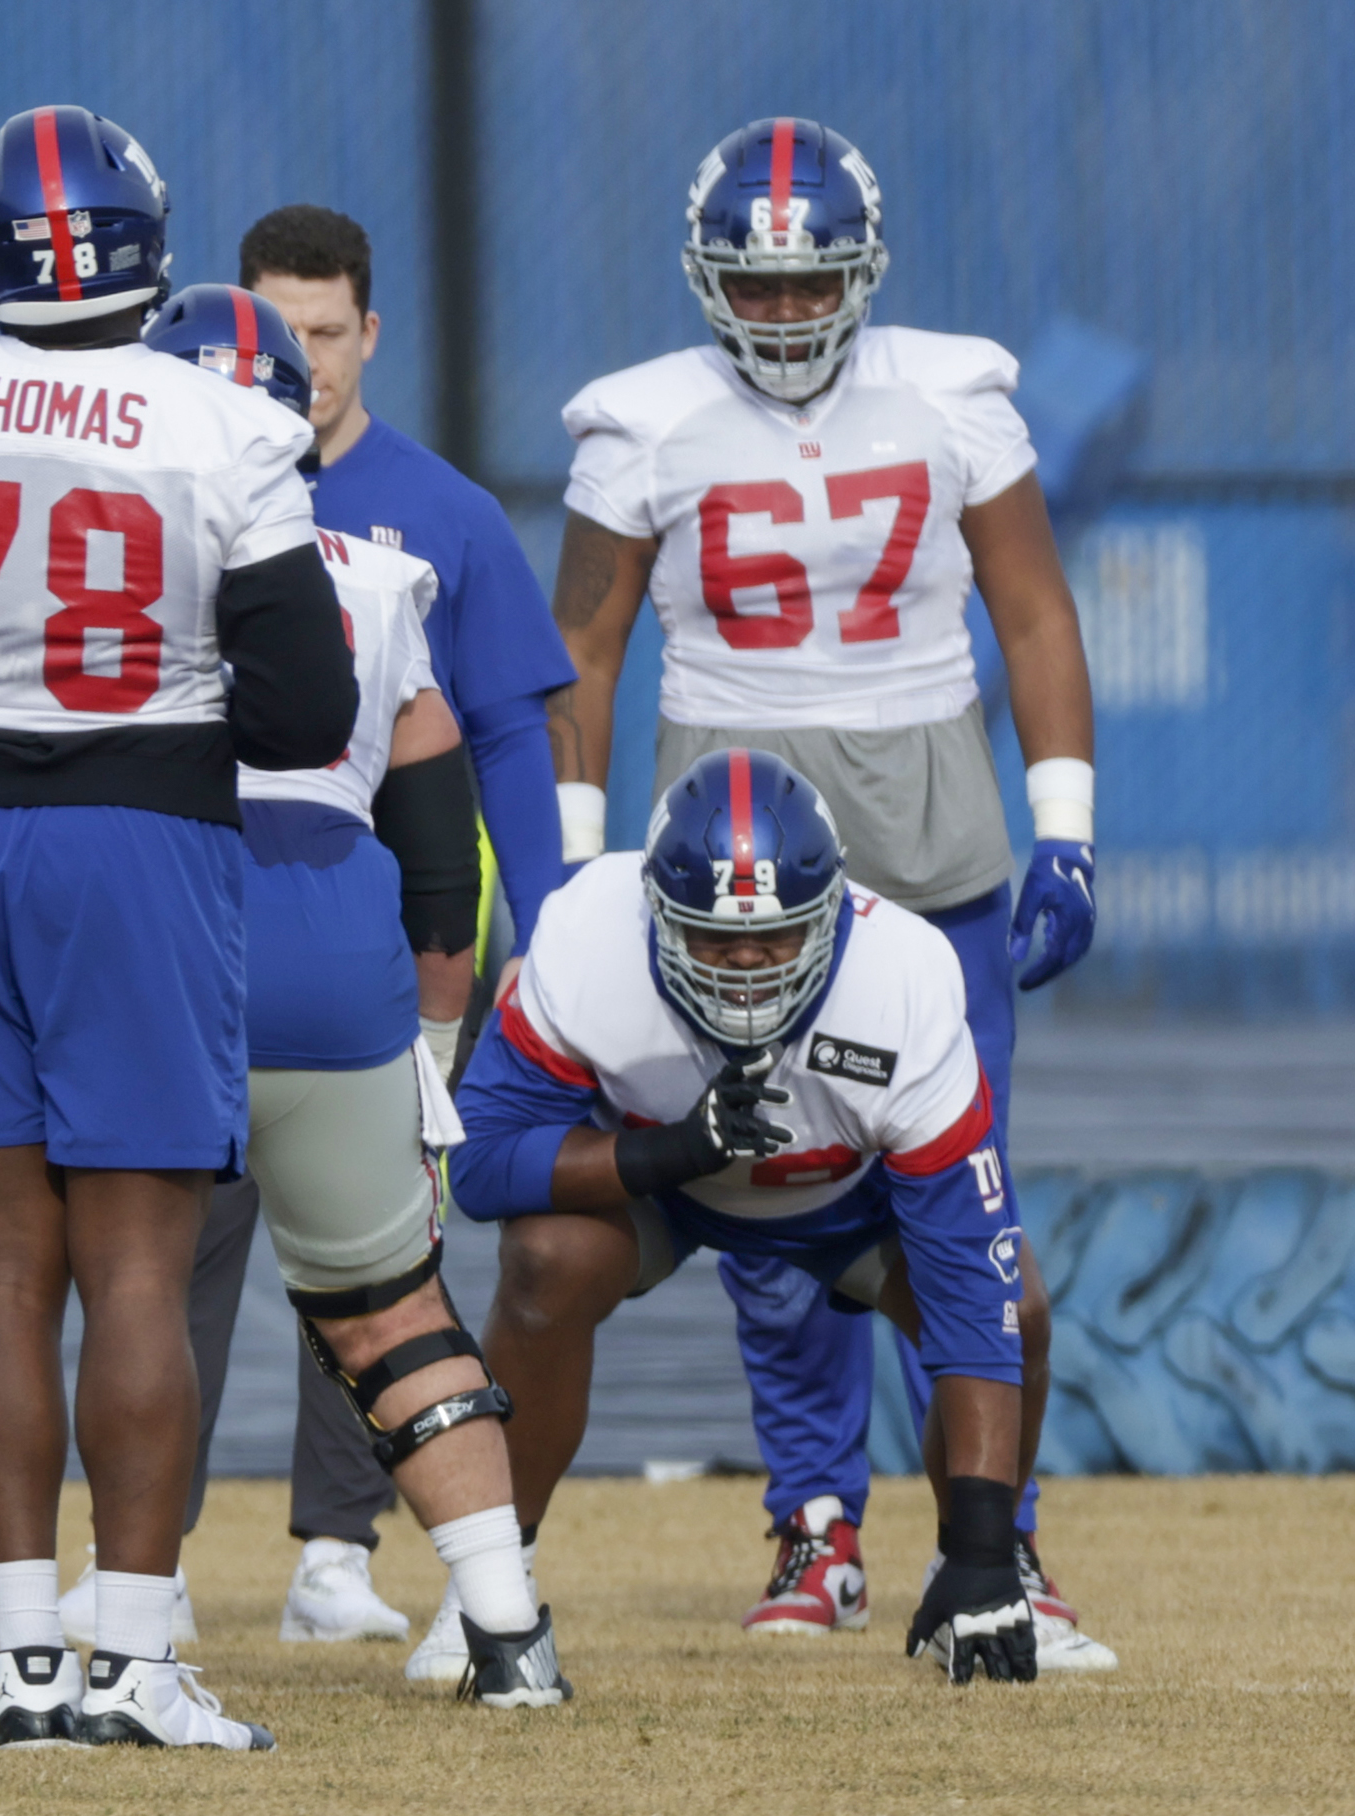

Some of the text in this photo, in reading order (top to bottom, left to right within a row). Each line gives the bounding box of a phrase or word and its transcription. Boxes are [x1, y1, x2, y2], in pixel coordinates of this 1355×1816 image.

[750, 196, 810, 232] 67
[32, 242, 97, 284] 78
[698, 460, 931, 650] 67
[712, 859, 776, 895] 79
